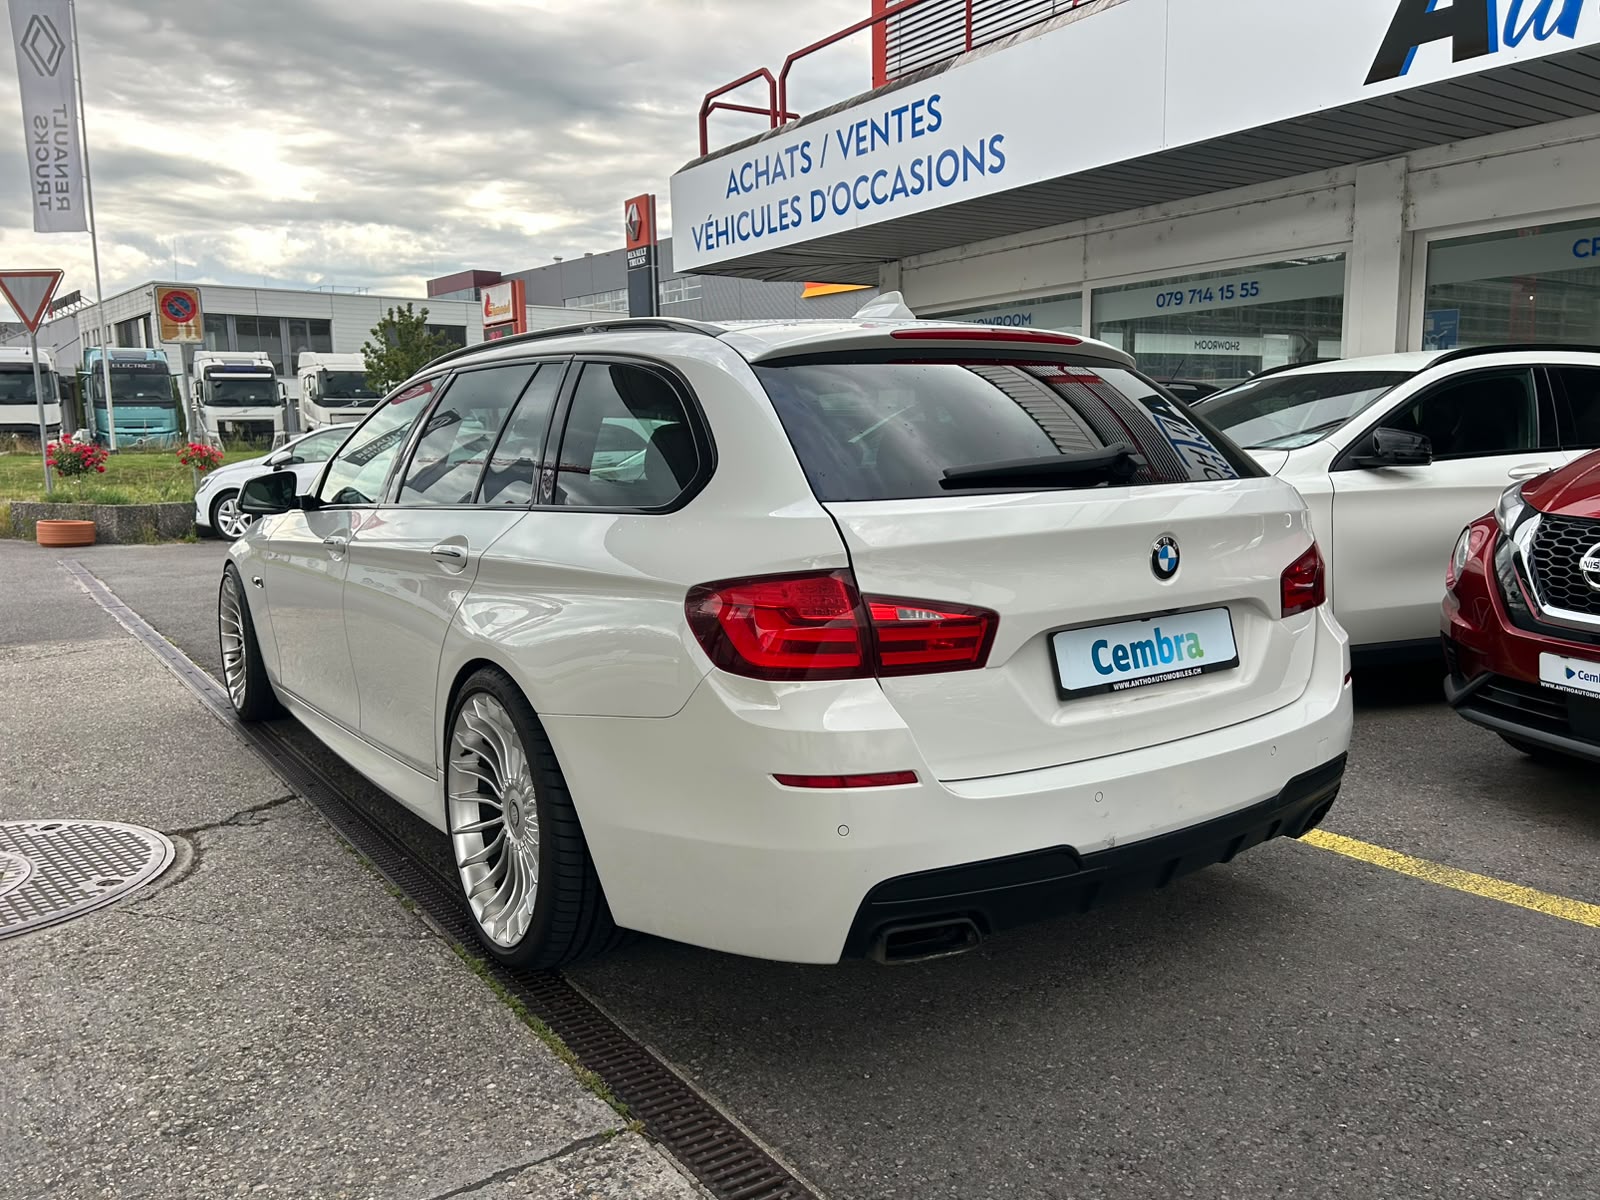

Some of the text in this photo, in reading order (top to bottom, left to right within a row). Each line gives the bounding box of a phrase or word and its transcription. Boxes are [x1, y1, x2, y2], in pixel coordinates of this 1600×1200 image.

[726, 94, 943, 199] ACHATS / VENTES
[691, 133, 1006, 252] VÉHICULES D'OCCASIONS
[627, 247, 647, 259] RENAULT
[629, 256, 646, 267] TRUCKS
[1156, 281, 1260, 308] 079 714 15 55
[963, 312, 1032, 326] OWROOM
[1091, 627, 1204, 676] Cembra
[1113, 667, 1203, 691] WWW.ANTHOAUTOMOBILES.CH
[1578, 670, 1600, 683] Cem
